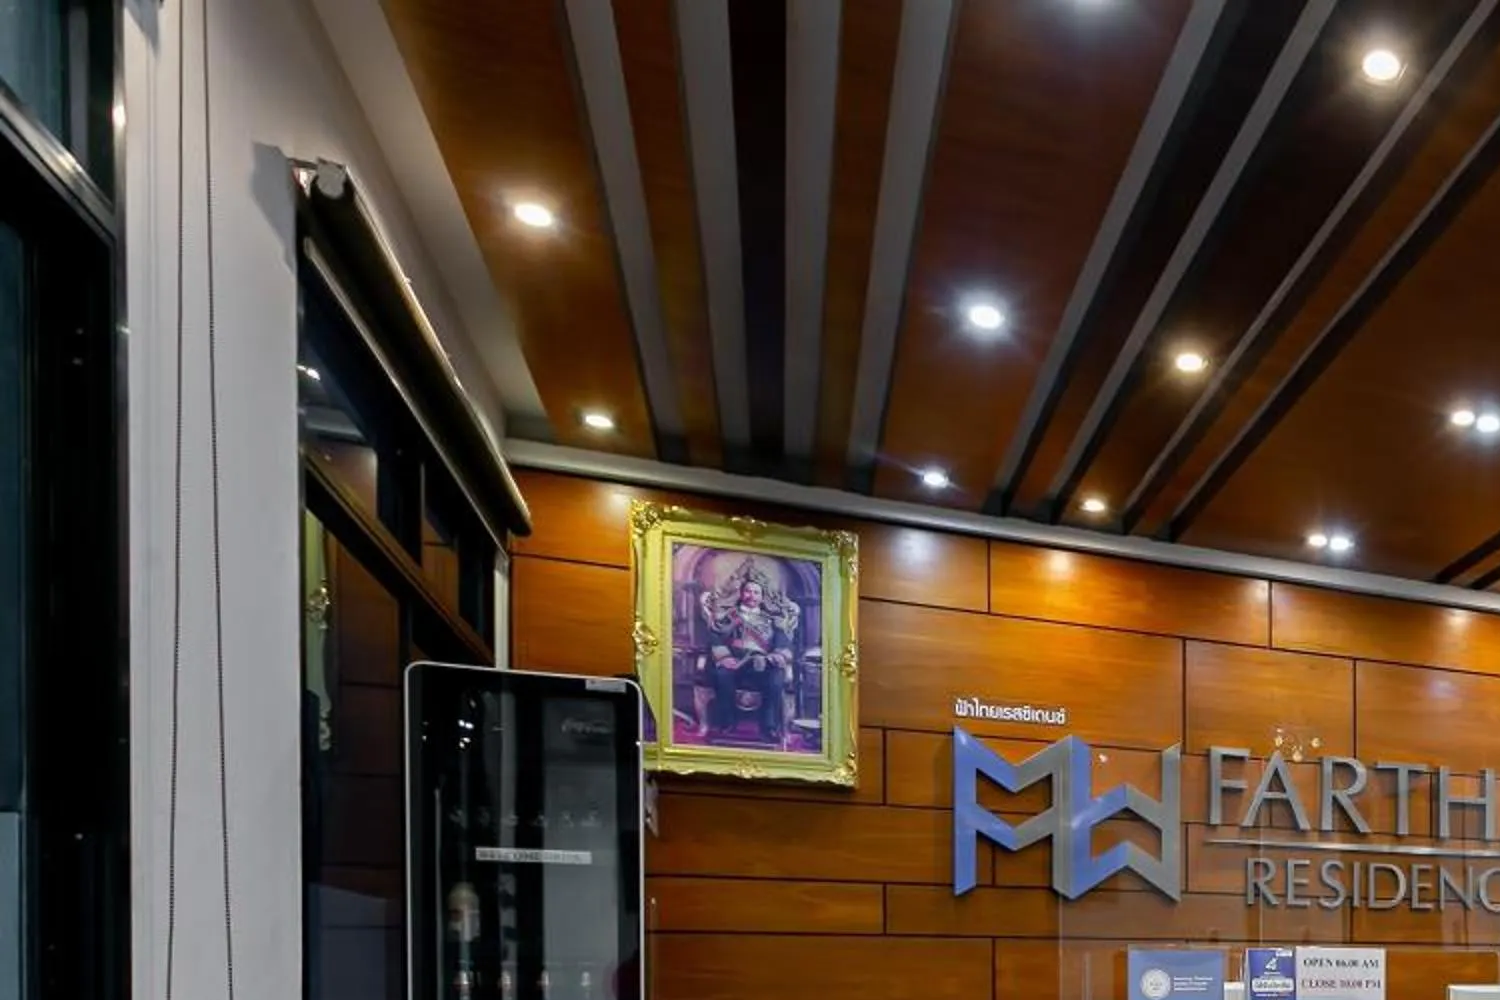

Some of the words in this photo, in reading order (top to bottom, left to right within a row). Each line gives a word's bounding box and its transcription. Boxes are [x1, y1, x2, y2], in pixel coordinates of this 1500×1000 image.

[1303, 957, 1333, 968] OPEN
[1362, 959, 1380, 969] AM
[1301, 978, 1337, 989] CLOSE
[1365, 978, 1381, 989] PM
